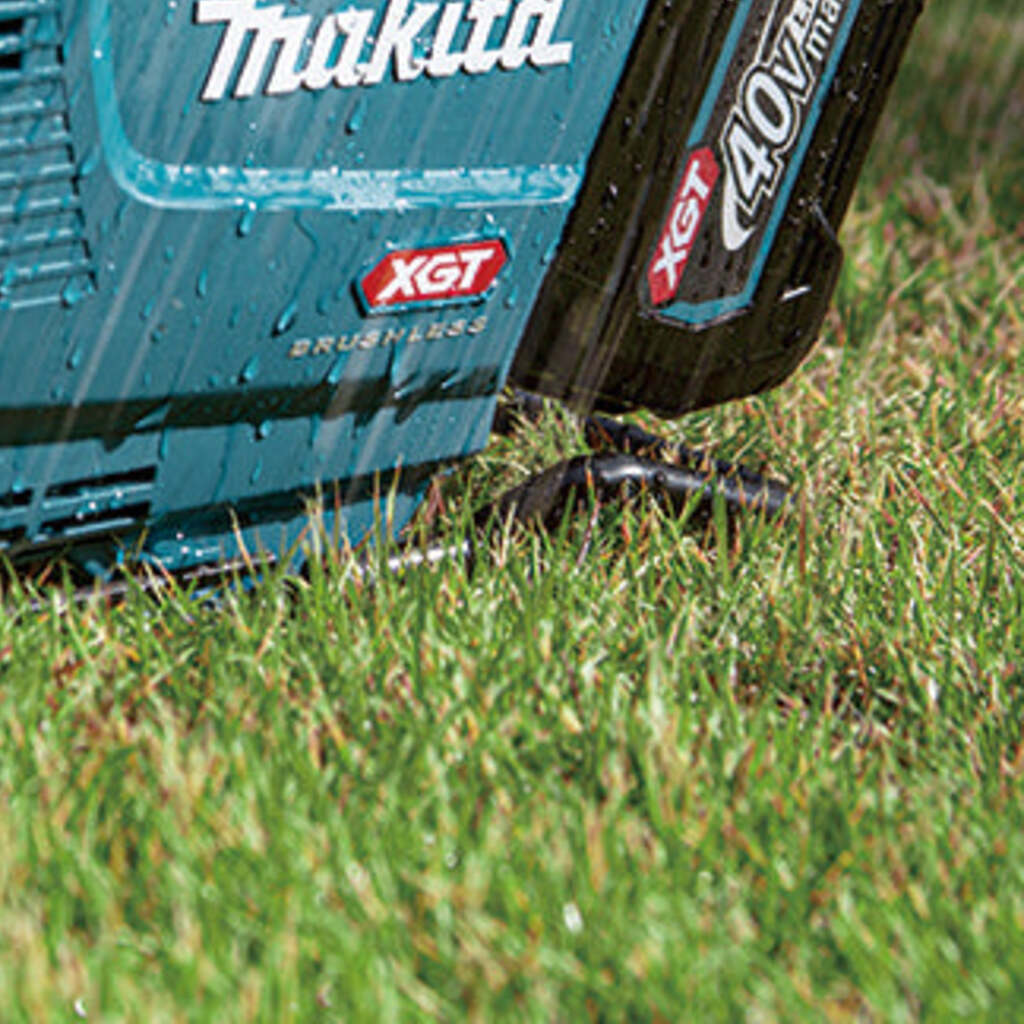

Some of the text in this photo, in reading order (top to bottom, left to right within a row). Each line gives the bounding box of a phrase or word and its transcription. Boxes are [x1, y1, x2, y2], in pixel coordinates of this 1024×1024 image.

[653, 160, 710, 290] XGT
[376, 249, 495, 301] XGT
[288, 316, 488, 358] BRUSHLESS
